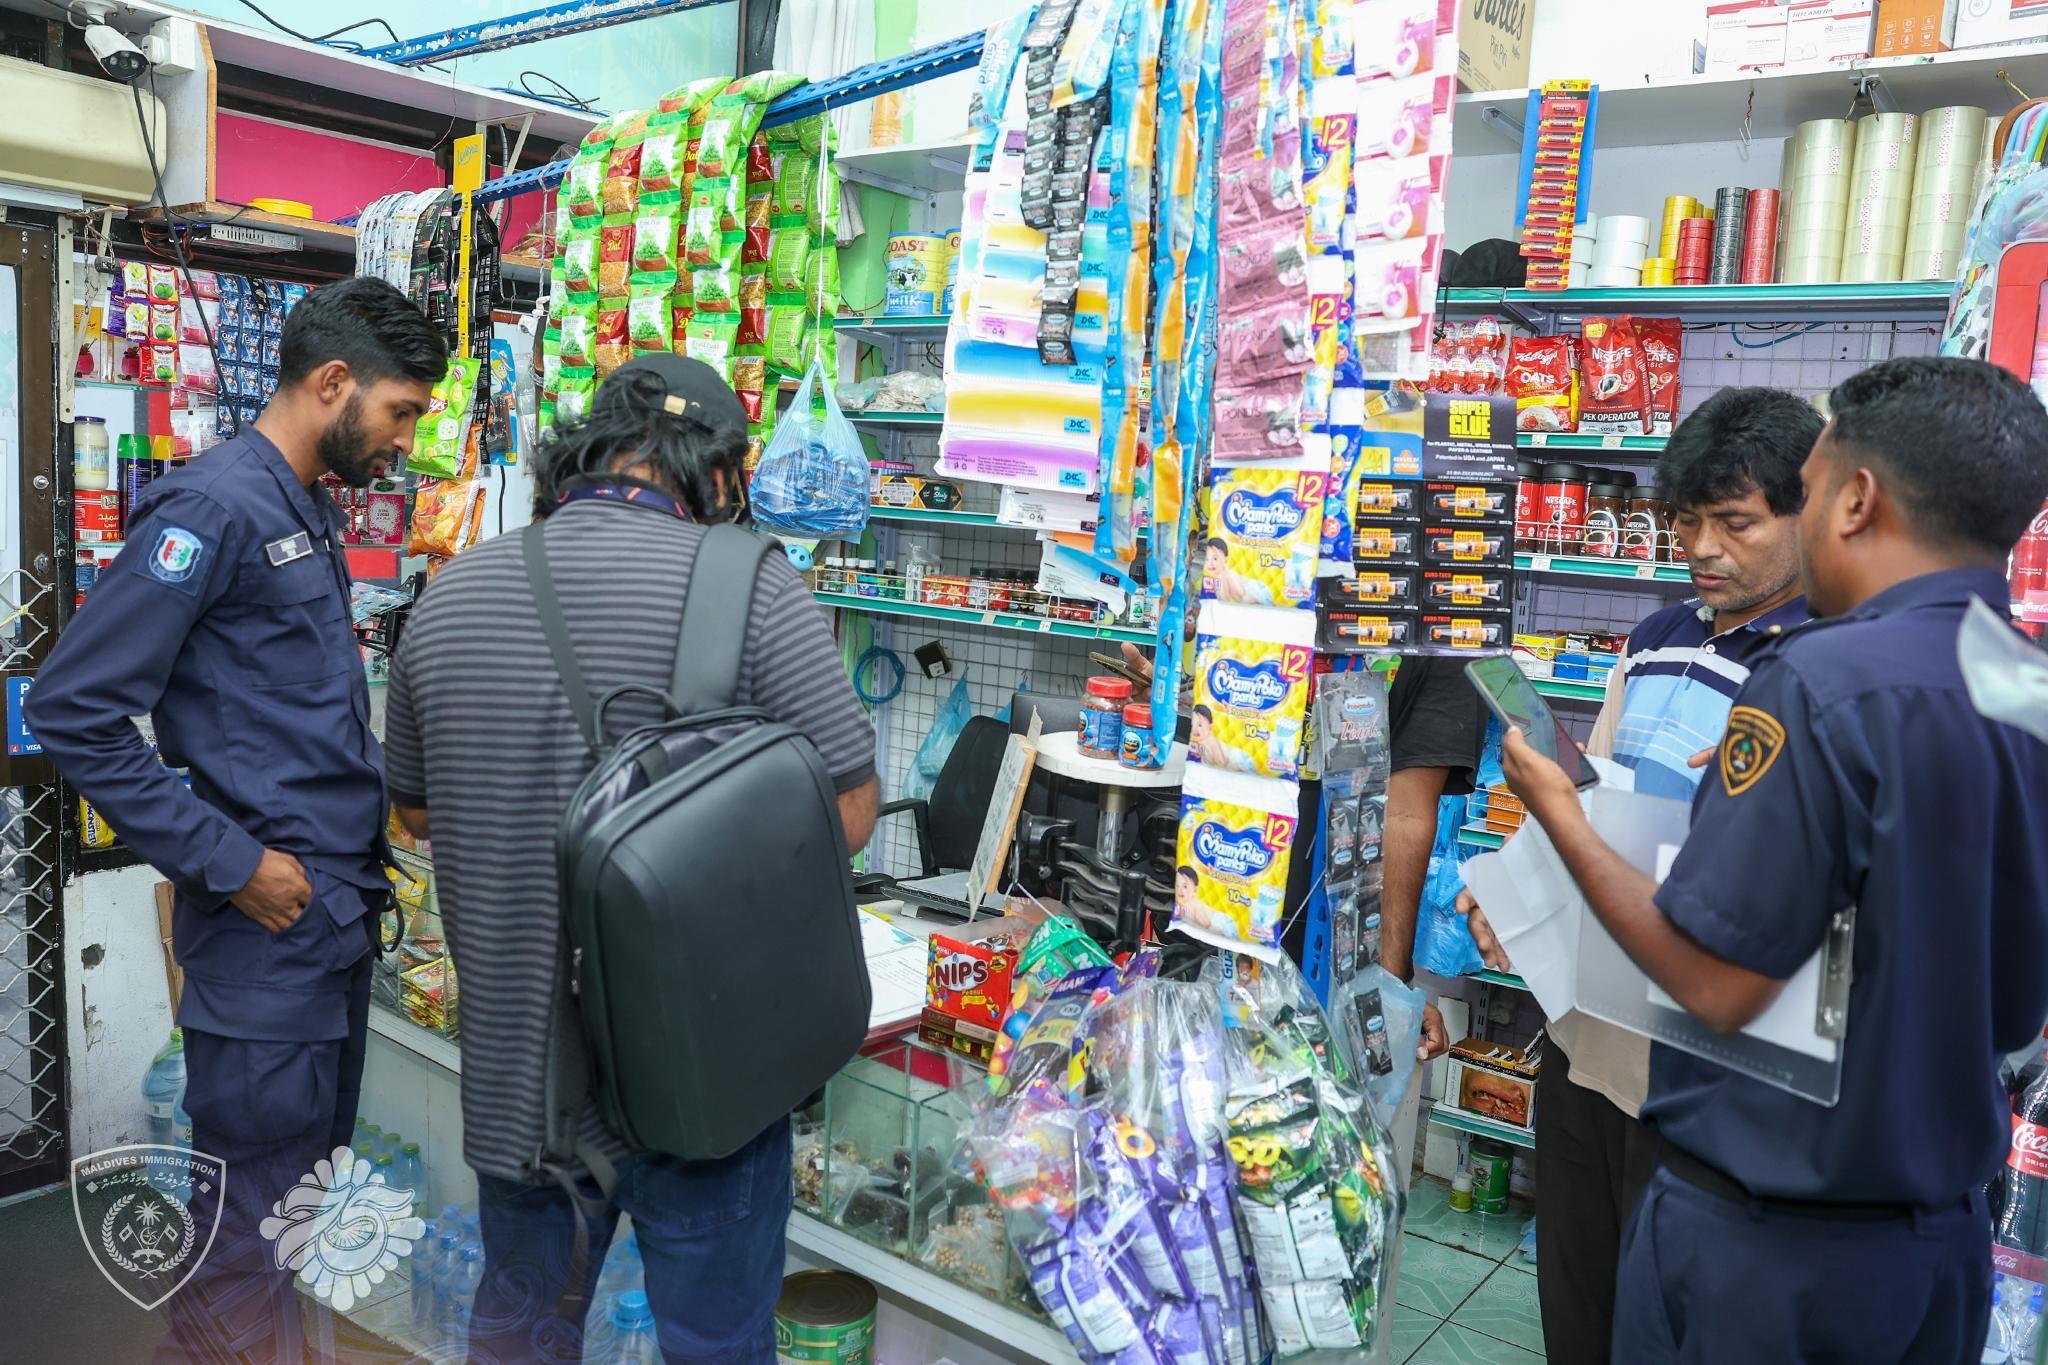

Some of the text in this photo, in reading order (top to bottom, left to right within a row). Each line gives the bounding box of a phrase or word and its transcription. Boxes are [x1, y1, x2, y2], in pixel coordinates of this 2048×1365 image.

[1322, 118, 1350, 147] 12
[890, 239, 928, 252] OAST
[1311, 297, 1336, 325] 12
[1520, 372, 1555, 384] OATS
[1449, 400, 1491, 416] SUPER
[1583, 411, 1639, 422] PEK OPERATOR
[1449, 415, 1491, 436] GLUE
[1297, 475, 1323, 503] 12
[1230, 492, 1300, 525] MamyPoko
[1246, 524, 1278, 536] pants
[1260, 554, 1272, 568] 10
[1282, 648, 1308, 678] 12
[1214, 662, 1284, 698] MamyPoko
[1230, 694, 1262, 706] pants
[1244, 723, 1256, 738] 10
[1264, 818, 1292, 848] 12
[1199, 824, 1268, 864] MamyPoko
[1214, 856, 1246, 872] pants
[1228, 888, 1241, 903] 10
[934, 960, 988, 988] NIPS
[962, 988, 984, 996] Peanut
